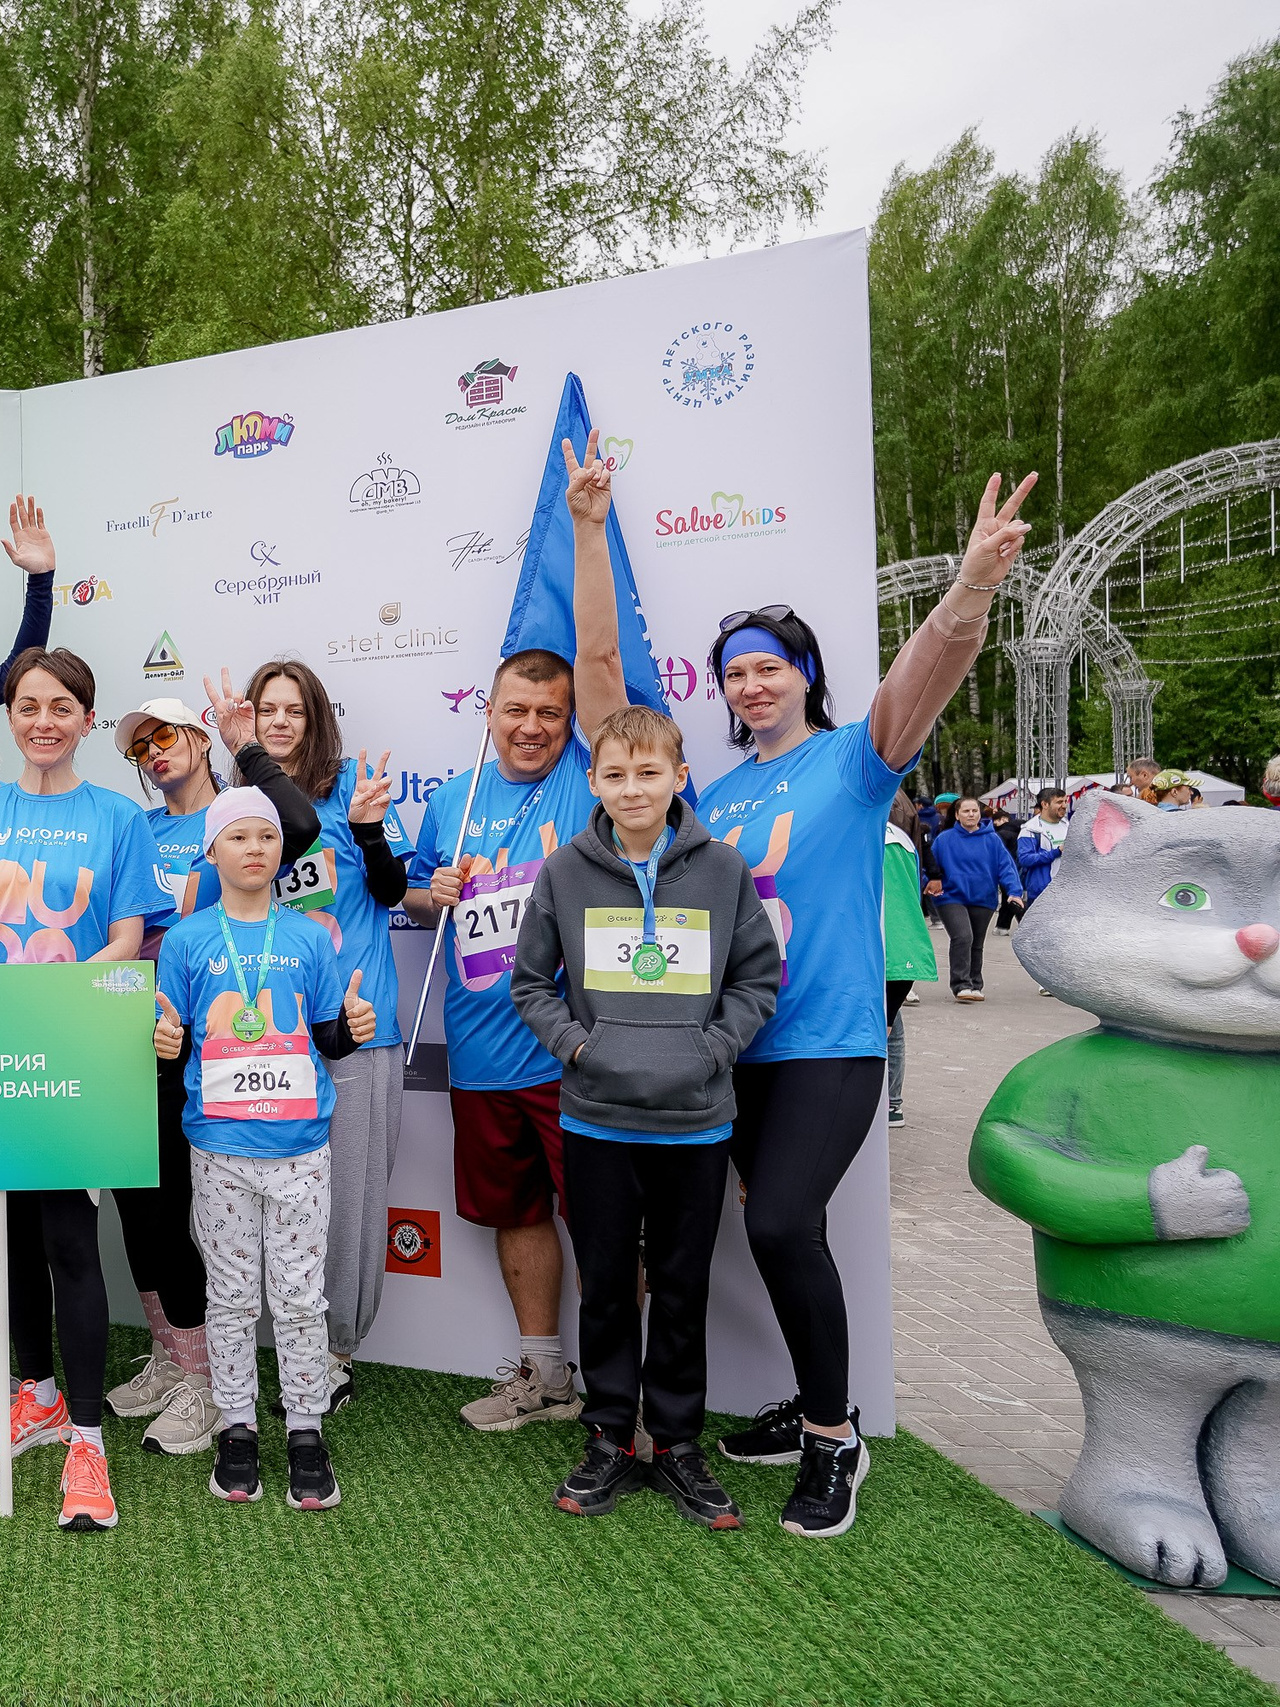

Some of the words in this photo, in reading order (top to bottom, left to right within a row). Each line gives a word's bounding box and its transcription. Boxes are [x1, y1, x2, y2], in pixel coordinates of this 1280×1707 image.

[662, 322, 733, 367] ДЕТСКОГО
[714, 334, 754, 406] РАЗВИТИЯ
[237, 441, 269, 456] парк
[106, 515, 150, 533] Fratelli
[171, 509, 213, 524] D'arte
[655, 506, 726, 536] Salve
[656, 540, 682, 549] Центр
[684, 534, 720, 546] детской
[721, 527, 787, 541] стоматологии
[214, 569, 321, 596] Серебряный
[394, 626, 458, 649] clinic
[395, 651, 434, 659] КОСМЕТОЛОГИИ
[16, 827, 88, 843] ЮГОРИЯ
[156, 843, 200, 855] ОРИЯ
[465, 898, 531, 940] 217
[617, 943, 680, 965] 32
[233, 1071, 291, 1093] 2804
